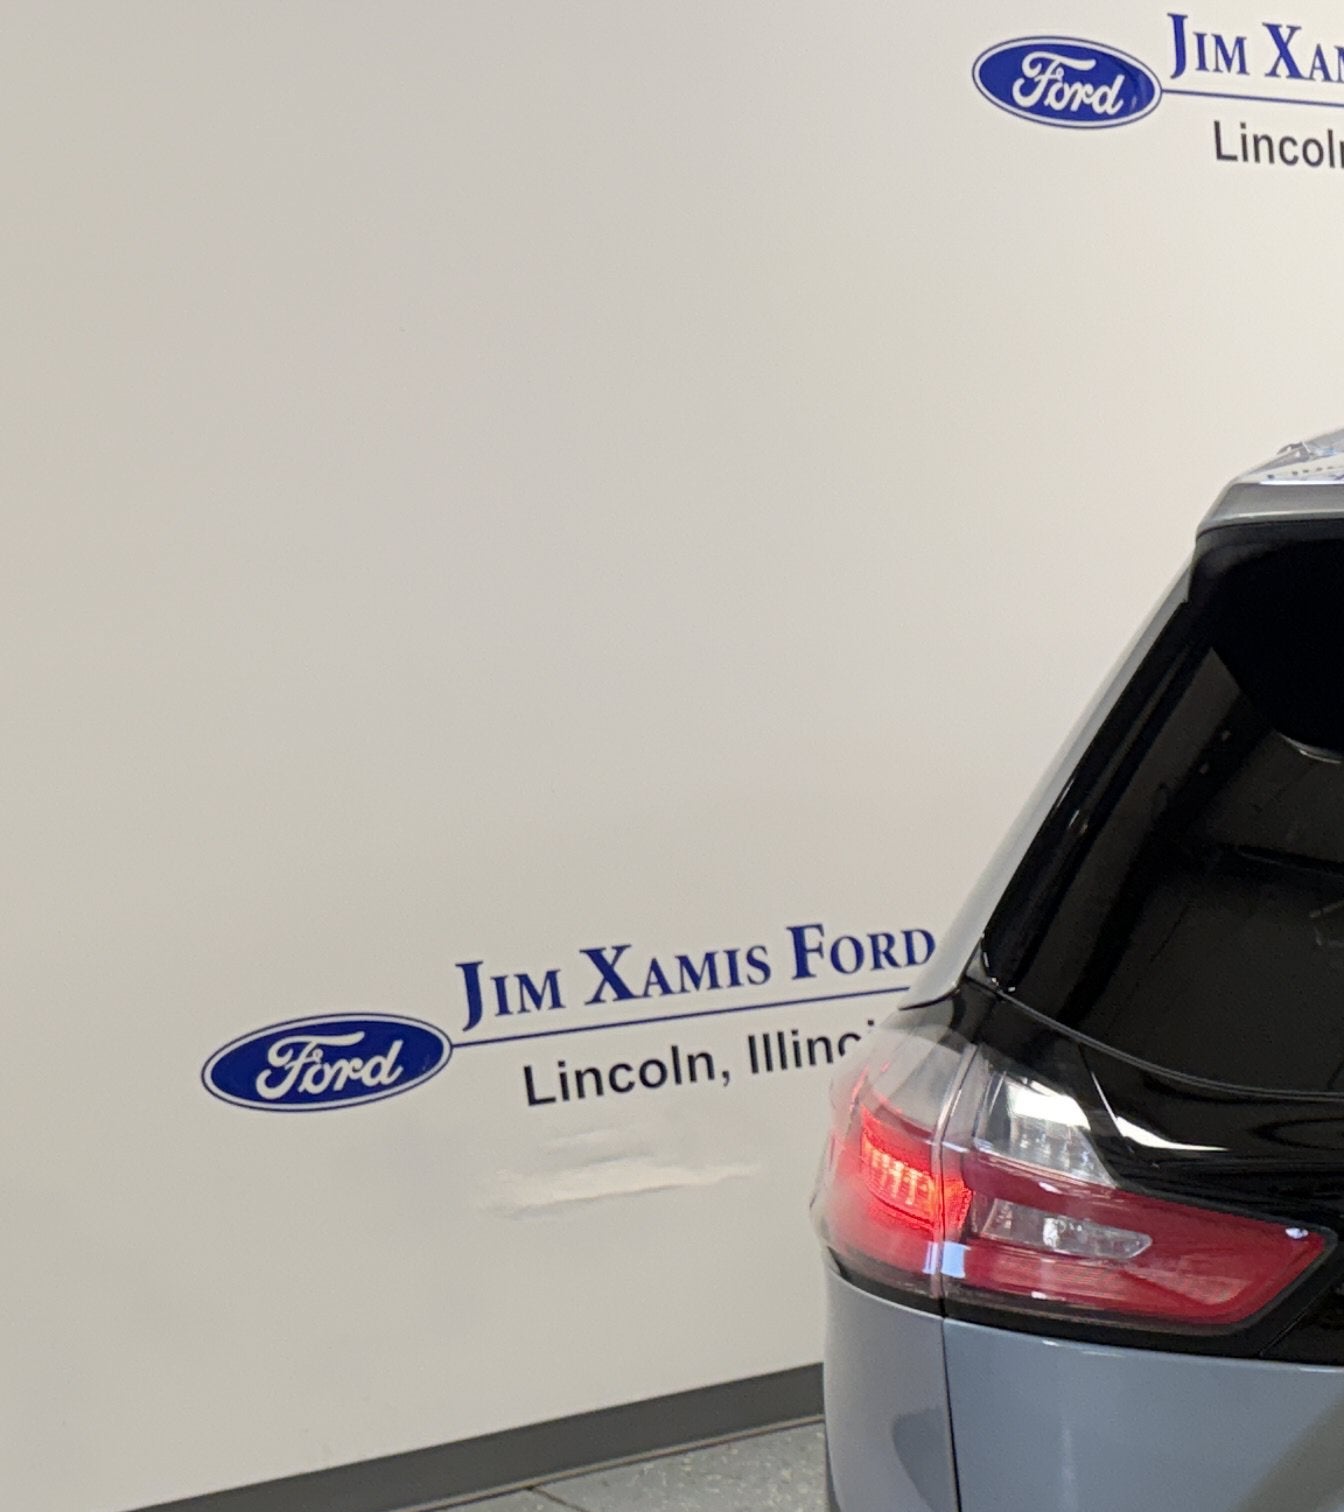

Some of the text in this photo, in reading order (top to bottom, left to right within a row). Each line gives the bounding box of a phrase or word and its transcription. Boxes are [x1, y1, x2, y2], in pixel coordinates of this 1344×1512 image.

[1167, 13, 1248, 79] JIM
[1012, 51, 1126, 117] Ford
[454, 923, 936, 1033] JIM XAMIS FORD
[254, 1030, 405, 1100] Ford
[523, 1043, 731, 1107] Lincoln,
